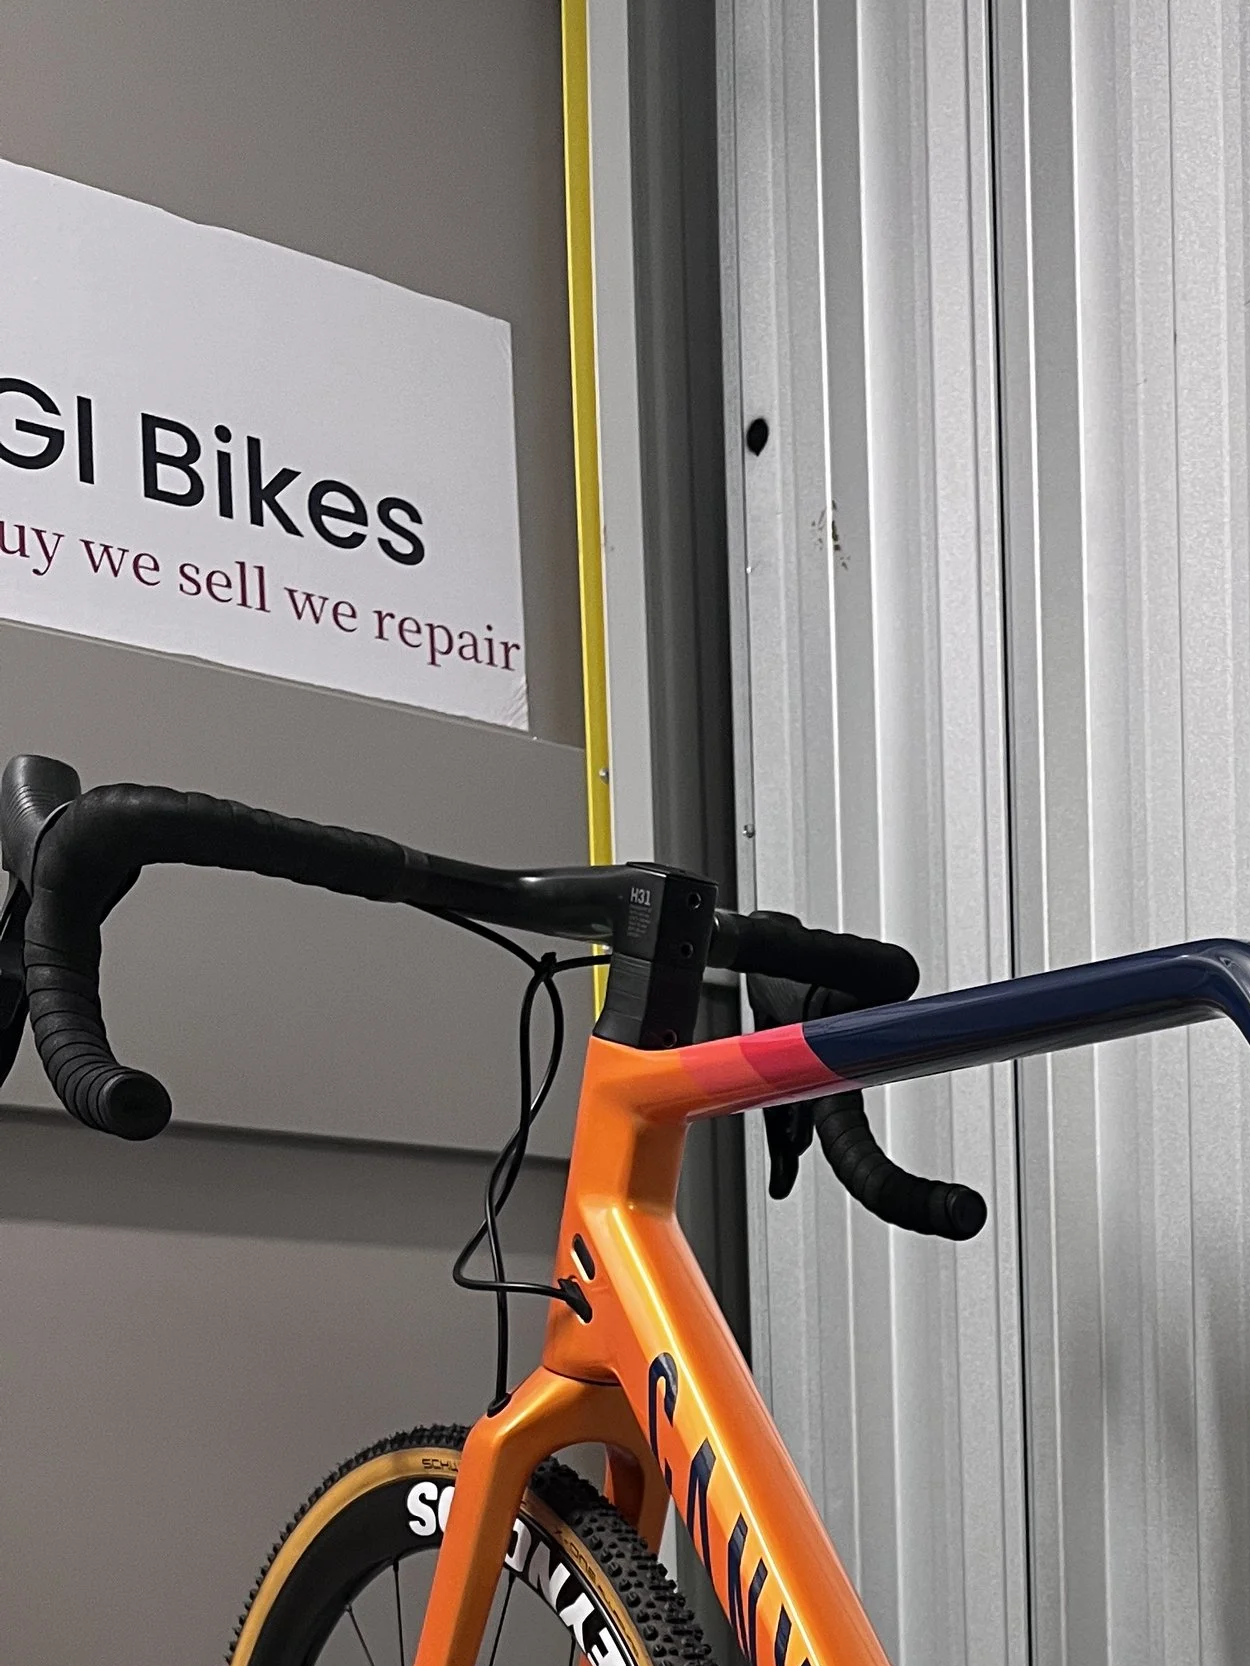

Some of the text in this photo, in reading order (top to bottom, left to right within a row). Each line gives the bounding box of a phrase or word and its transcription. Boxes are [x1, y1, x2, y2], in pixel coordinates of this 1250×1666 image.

[141, 412, 425, 566] Bikes
[79, 538, 161, 586] we
[178, 560, 271, 613] sell
[284, 586, 358, 633] we
[373, 609, 521, 671] repair
[630, 887, 651, 906] H31
